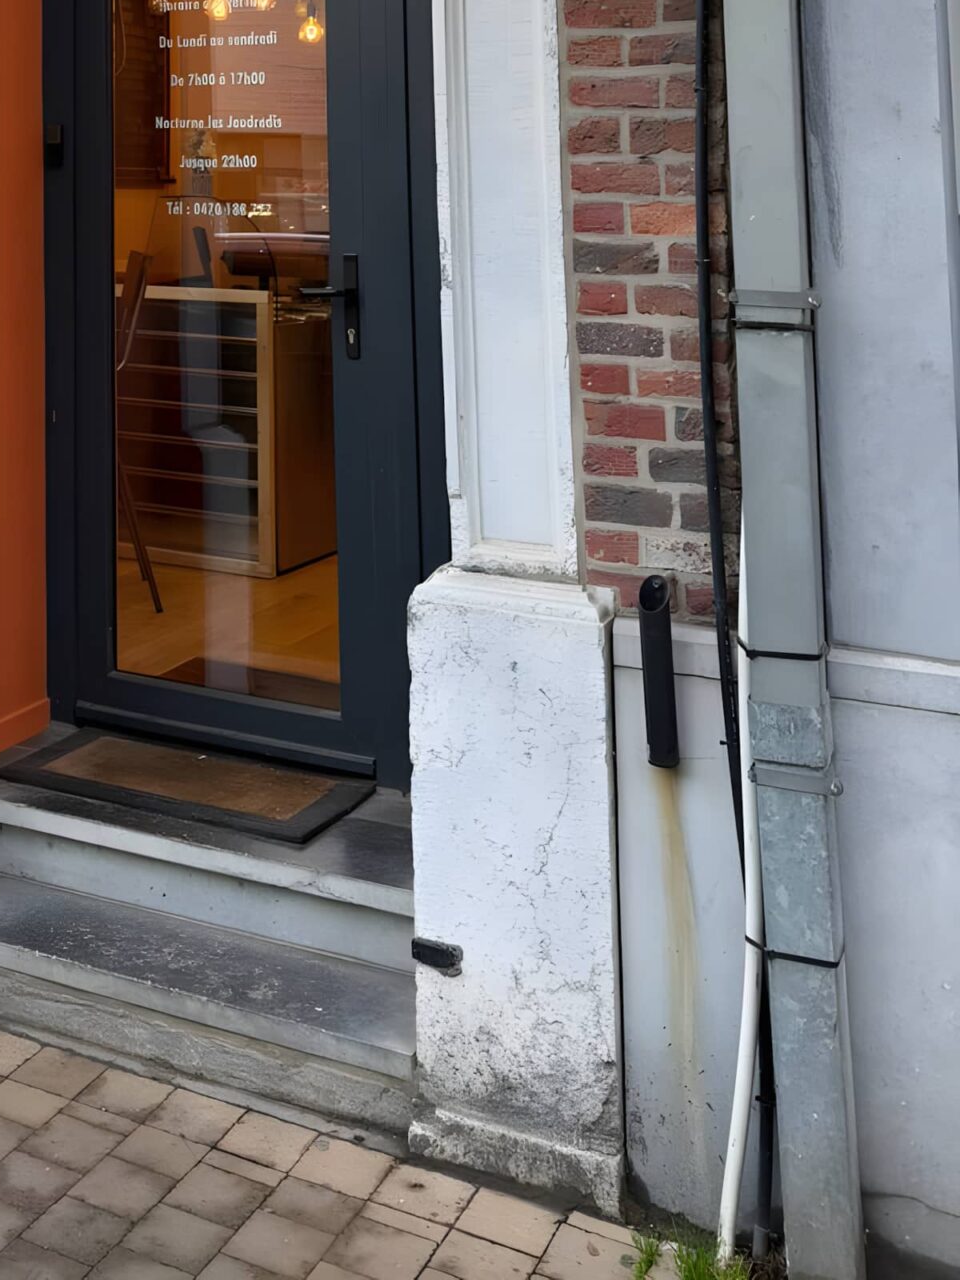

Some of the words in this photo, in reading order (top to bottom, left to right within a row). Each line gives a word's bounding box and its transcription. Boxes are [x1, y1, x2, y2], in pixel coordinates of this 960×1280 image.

[159, 36, 173, 48] Du
[177, 34, 207, 48] Lundi
[188, 73, 216, 86] 7h00
[230, 71, 266, 85] 17h00
[155, 116, 204, 129] Nocturne
[179, 155, 218, 170] Jusque
[221, 154, 257, 168] 22h00
[166, 201, 183, 215] Tél
